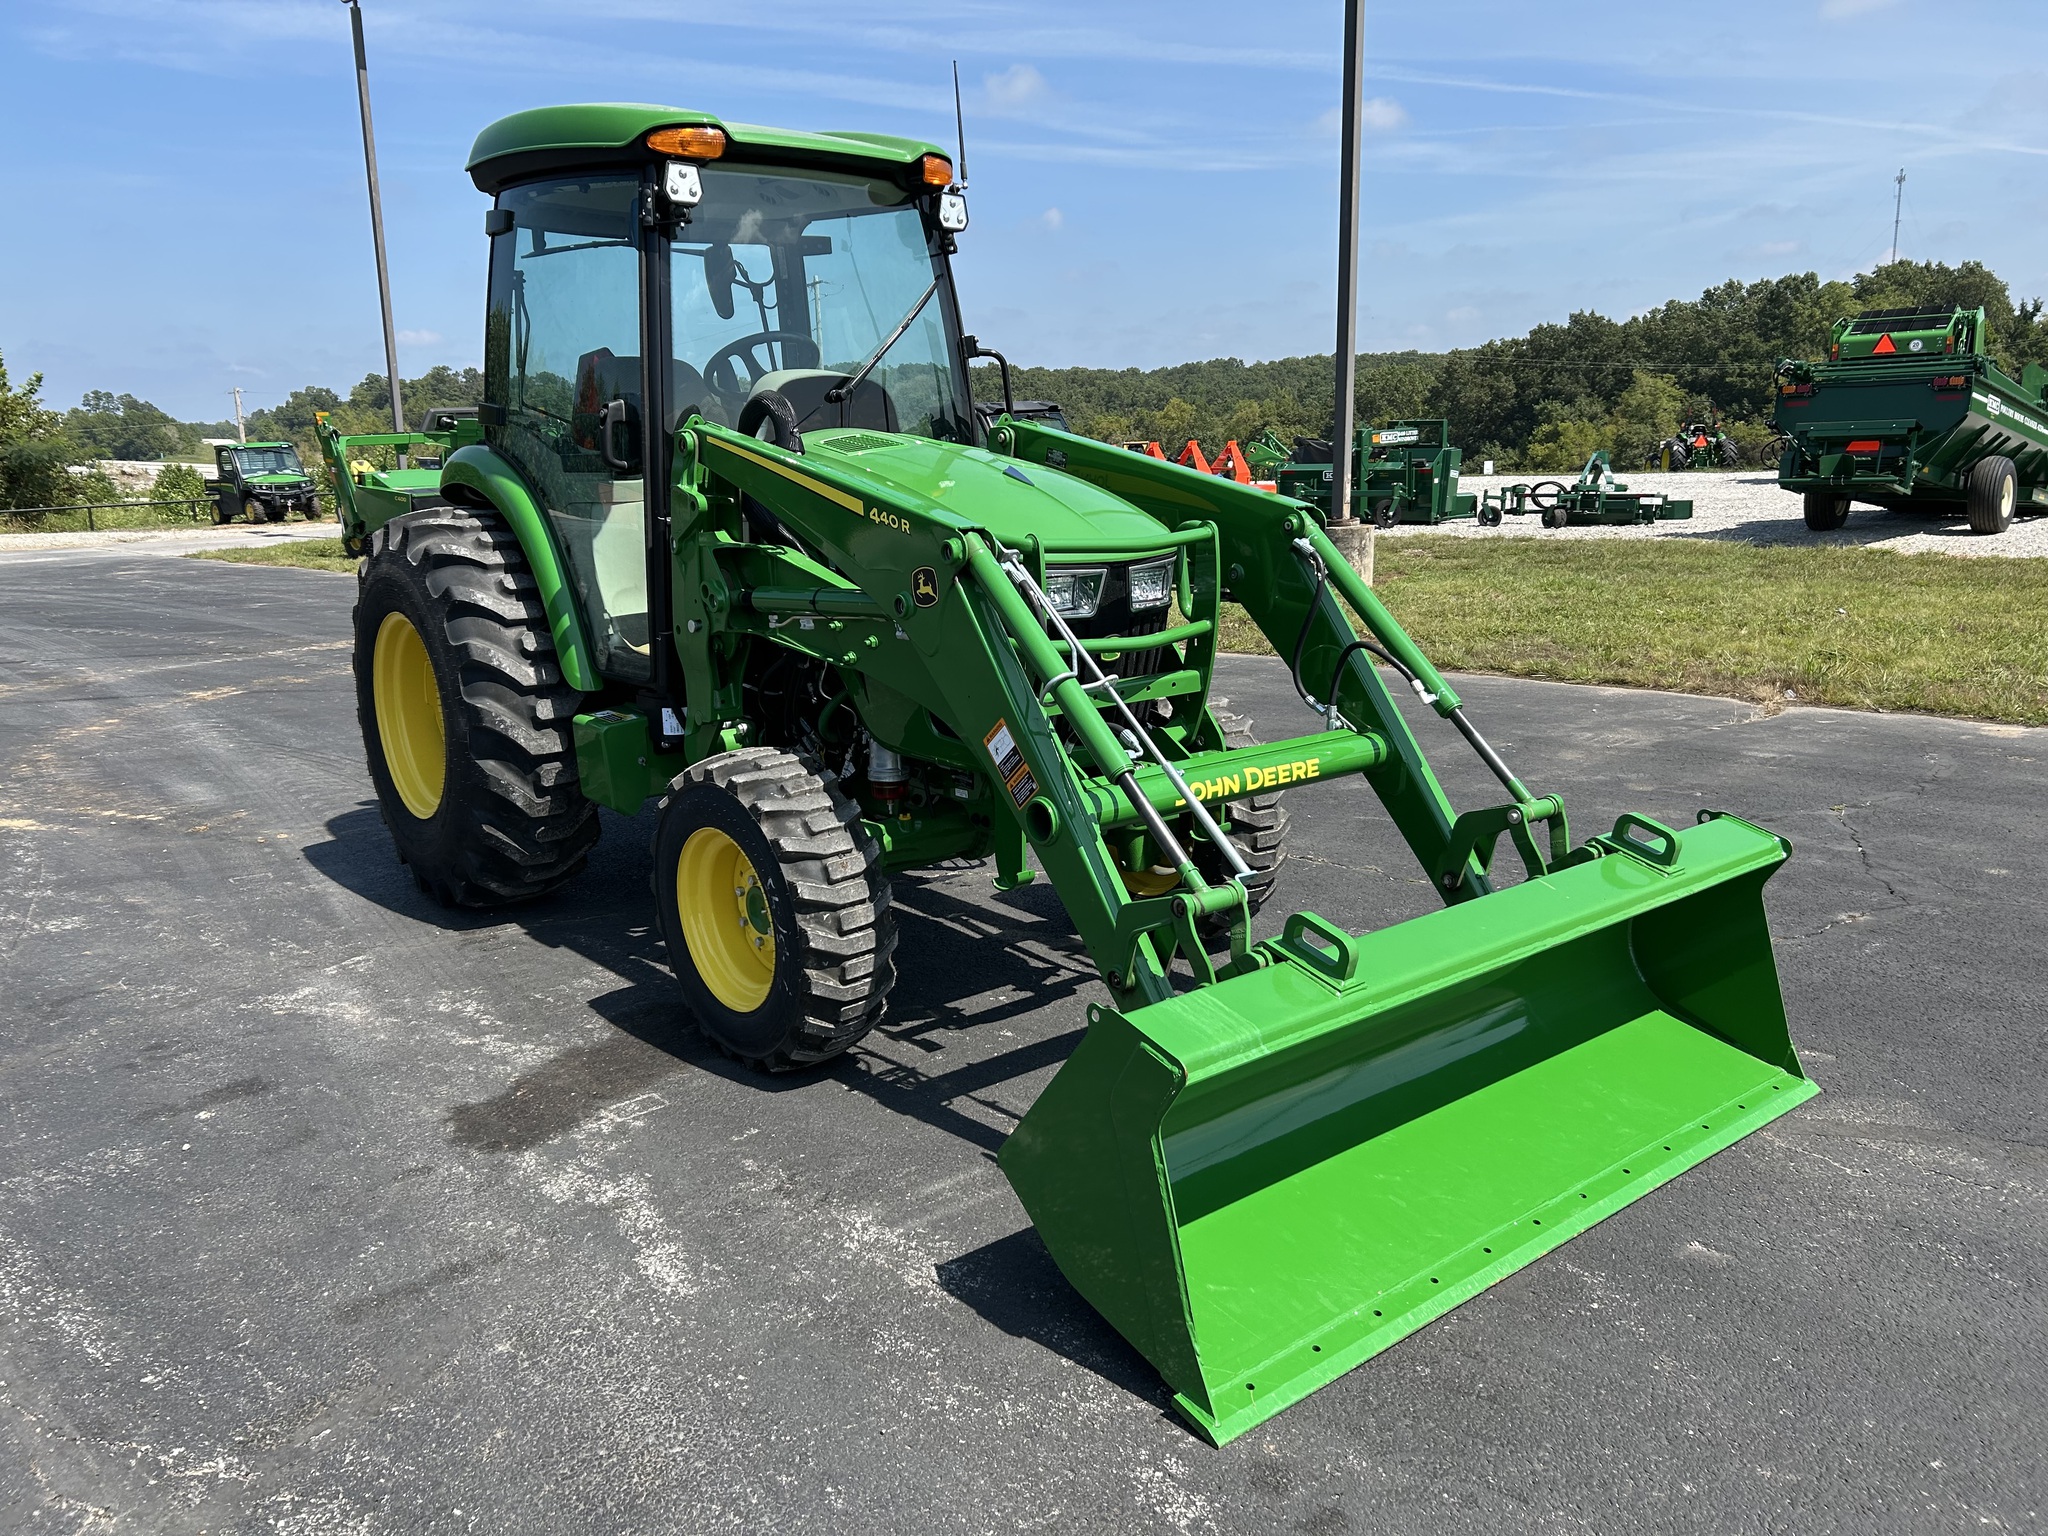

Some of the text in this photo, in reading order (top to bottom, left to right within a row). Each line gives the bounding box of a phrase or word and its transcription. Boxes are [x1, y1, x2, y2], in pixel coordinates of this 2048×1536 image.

[1380, 433, 1398, 442] KMC
[869, 507, 911, 535] 440 R
[1243, 758, 1320, 792] DEERE
